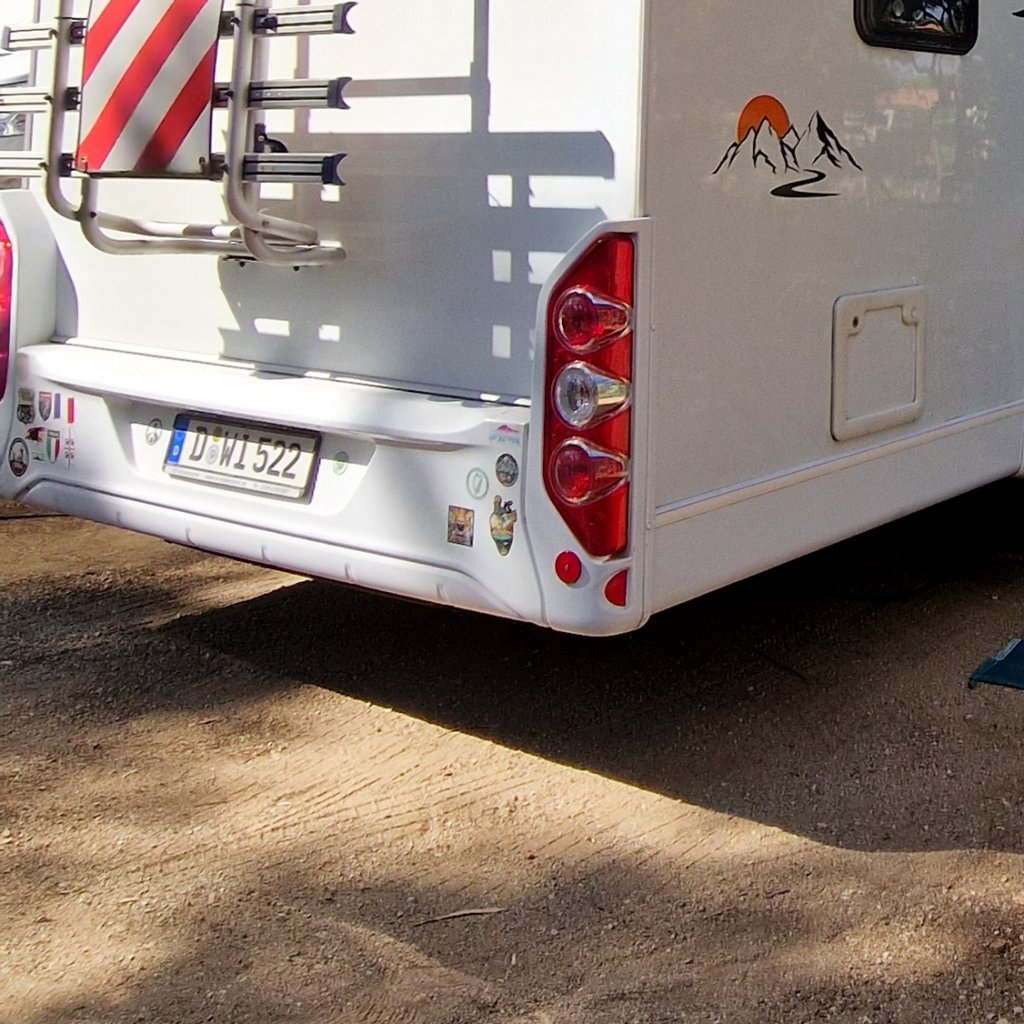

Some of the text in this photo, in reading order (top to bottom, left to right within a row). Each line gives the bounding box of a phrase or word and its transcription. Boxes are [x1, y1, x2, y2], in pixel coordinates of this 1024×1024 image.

[189, 426, 302, 480] D WI 522
